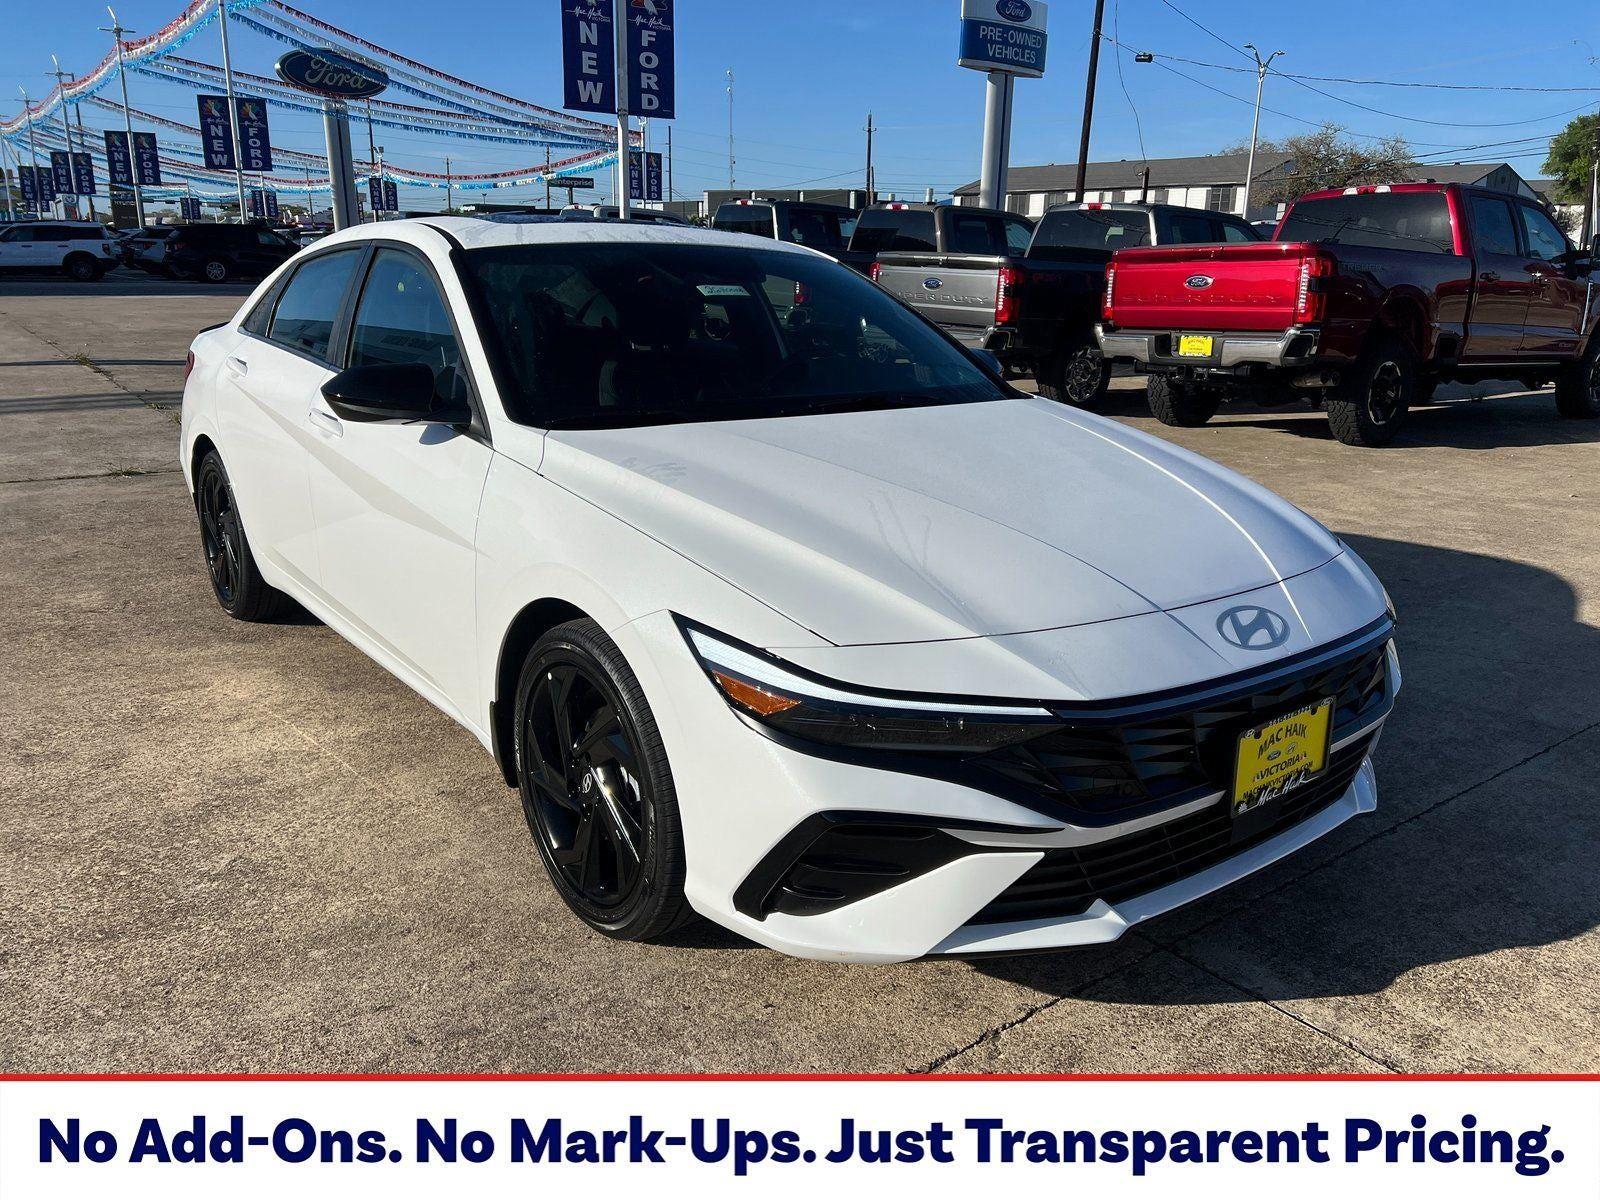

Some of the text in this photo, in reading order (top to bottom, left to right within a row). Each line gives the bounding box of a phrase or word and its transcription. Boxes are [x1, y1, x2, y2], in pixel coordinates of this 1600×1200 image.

[1005, 1, 1027, 17] Ford
[980, 25, 1043, 49] PRE-OWNED
[577, 20, 603, 104] NEW
[987, 43, 1036, 64] VEHICLES
[305, 58, 366, 89] Ford
[639, 29, 660, 110] FORD
[210, 124, 227, 166] NEW
[248, 127, 263, 168] FORD
[58, 168, 69, 192] NEW
[113, 152, 128, 182] NEW
[142, 153, 154, 184] FORD
[631, 170, 640, 198] NEW
[650, 171, 659, 199] FORD
[1258, 722, 1307, 759] MAC HAIK
[1260, 753, 1301, 780] VICTORIA
